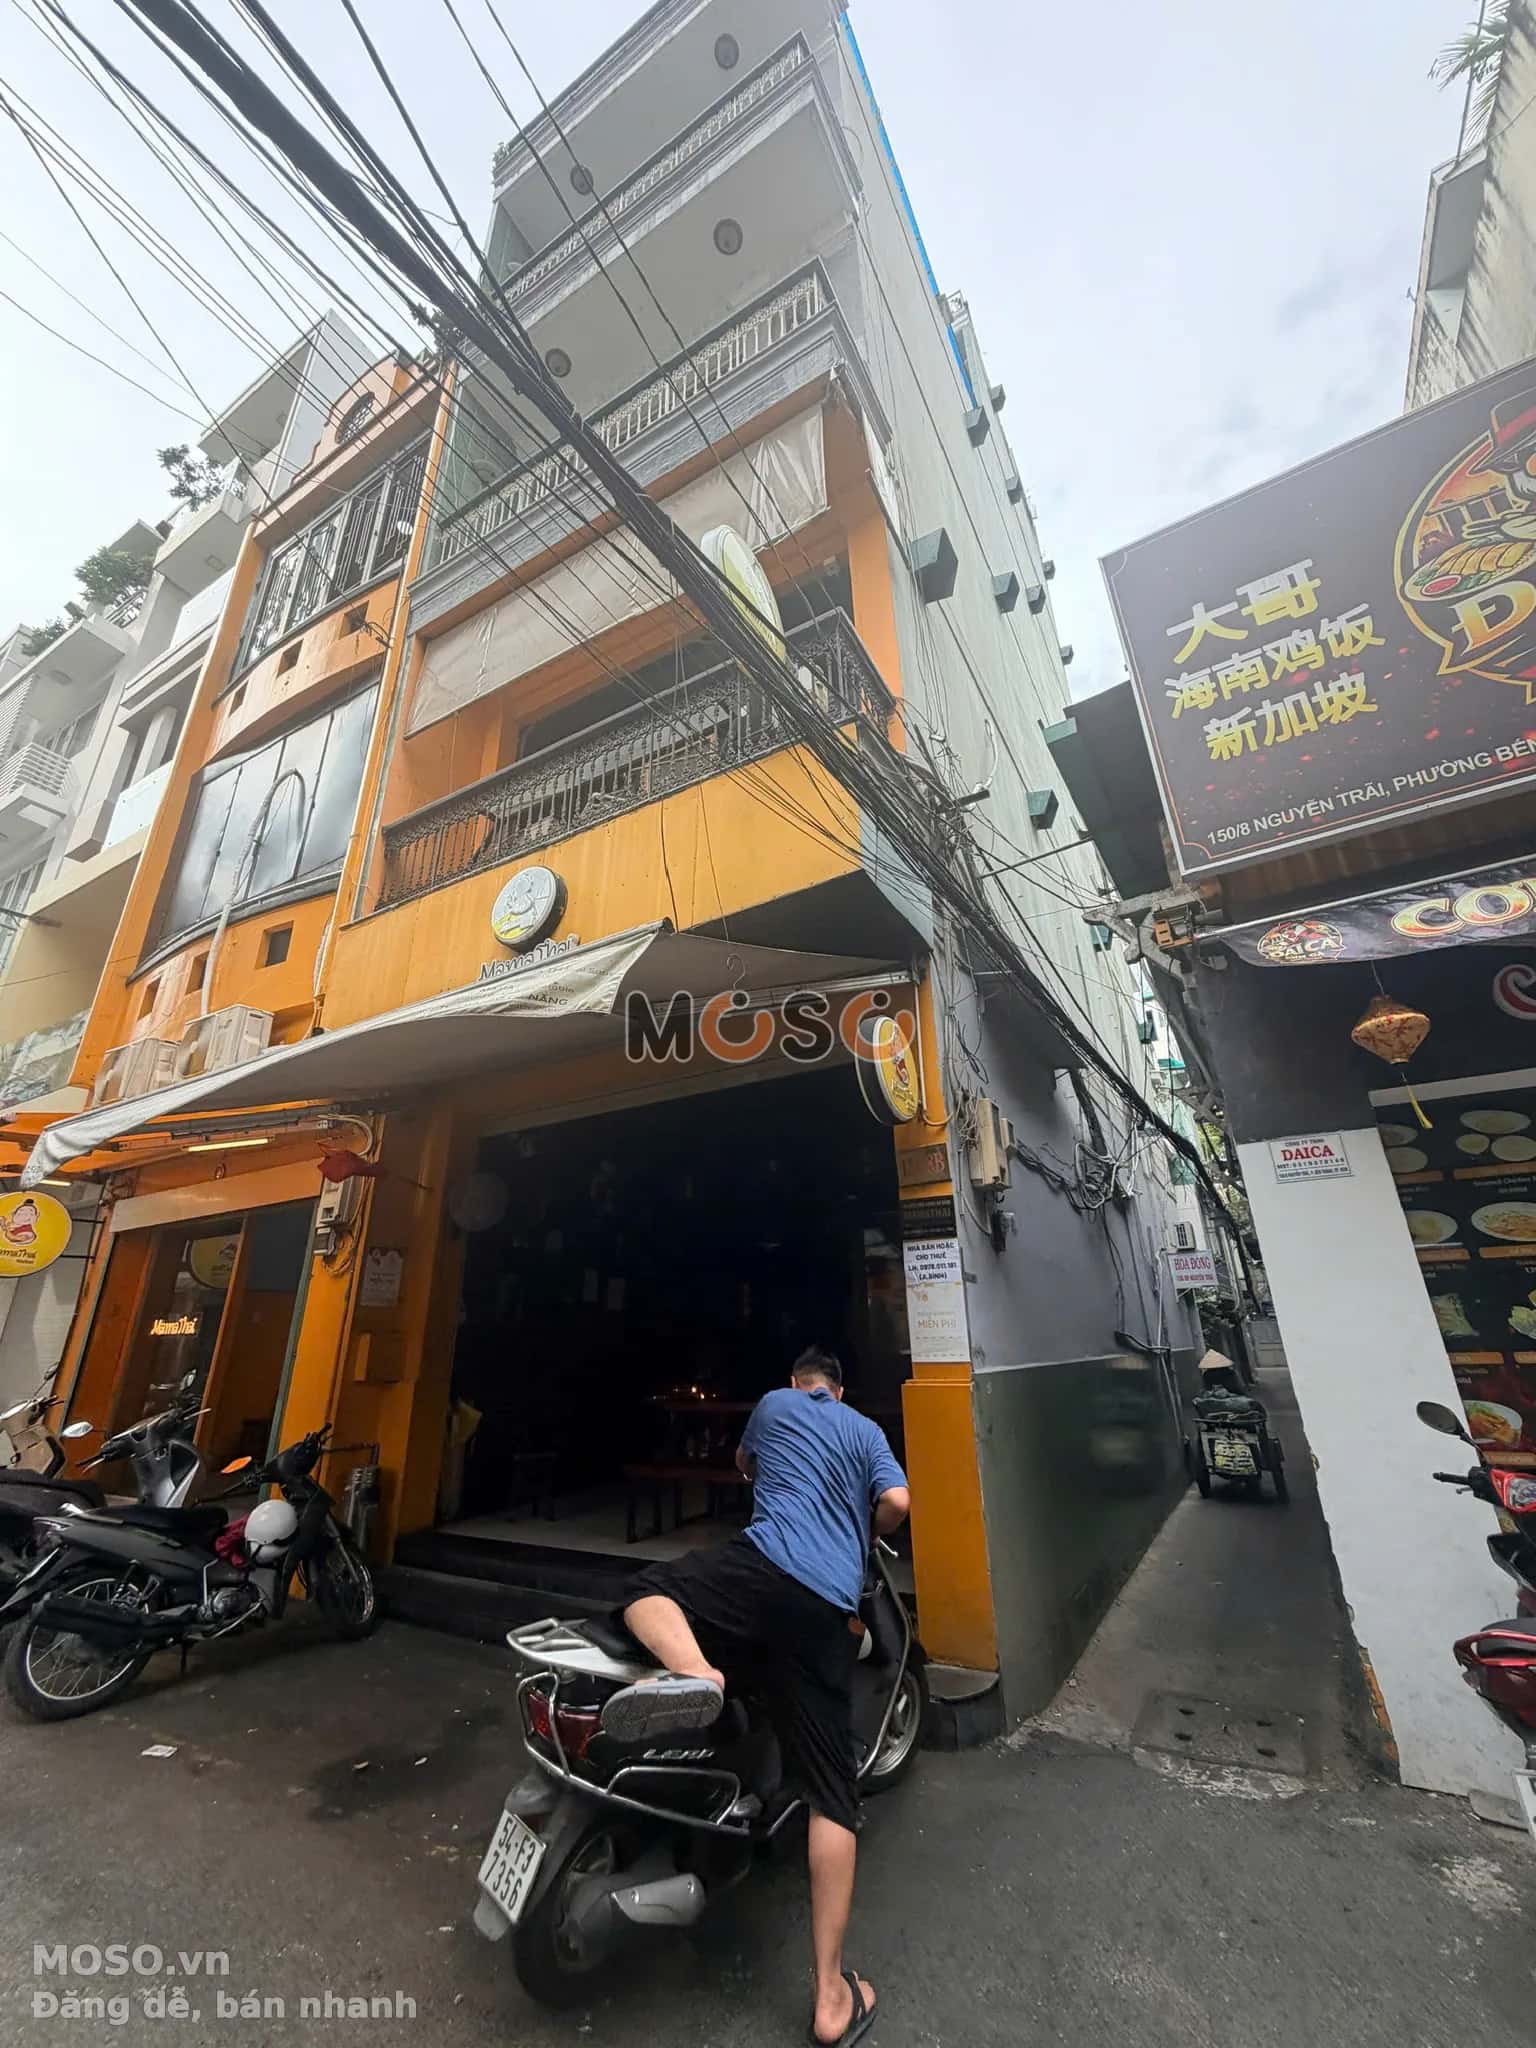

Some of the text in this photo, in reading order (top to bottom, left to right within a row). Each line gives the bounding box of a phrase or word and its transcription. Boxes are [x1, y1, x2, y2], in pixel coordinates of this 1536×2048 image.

[1165, 558, 1322, 665] 大哥
[1163, 602, 1387, 720] 海南鸡饭
[1202, 671, 1379, 761] 新加坡
[1207, 822, 1251, 845] 150/8
[1254, 797, 1335, 832] NGUYỄN
[1336, 781, 1391, 808] TRÃI,
[1392, 752, 1493, 792] PHƯỜNG
[1281, 1144, 1335, 1161] DAICA
[484, 1849, 522, 1911] 7356
